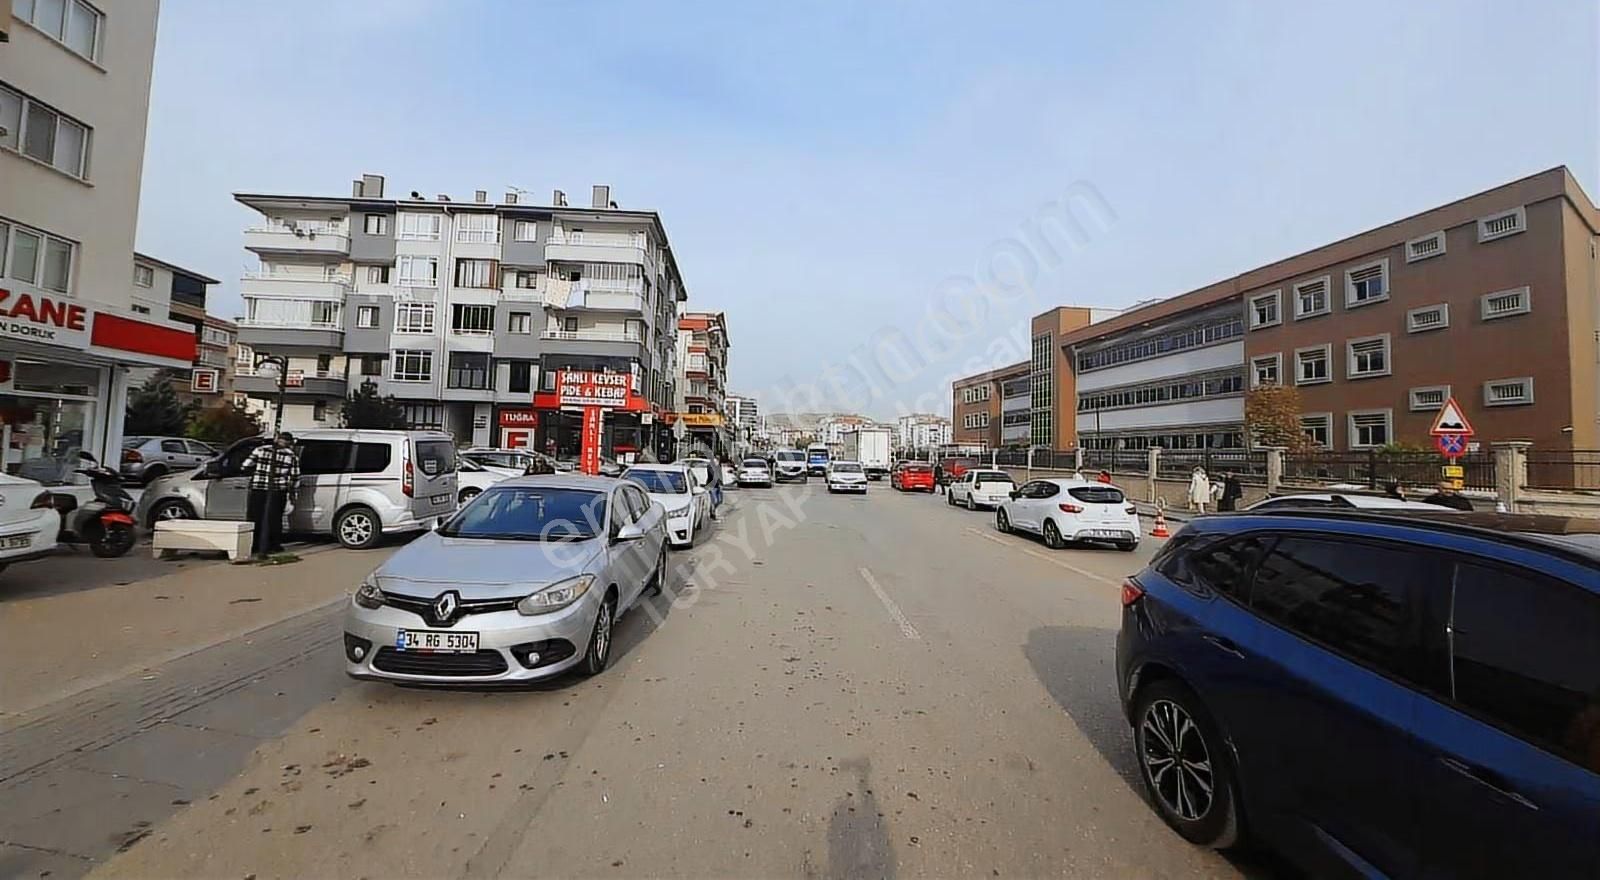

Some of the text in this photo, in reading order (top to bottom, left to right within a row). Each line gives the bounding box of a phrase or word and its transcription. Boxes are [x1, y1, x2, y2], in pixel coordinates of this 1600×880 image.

[10, 323, 54, 339] DORUK
[592, 373, 626, 386] KEVSER
[585, 388, 592, 396] &
[595, 385, 626, 399] KEBAP
[406, 633, 476, 649] 34 RG 5304
